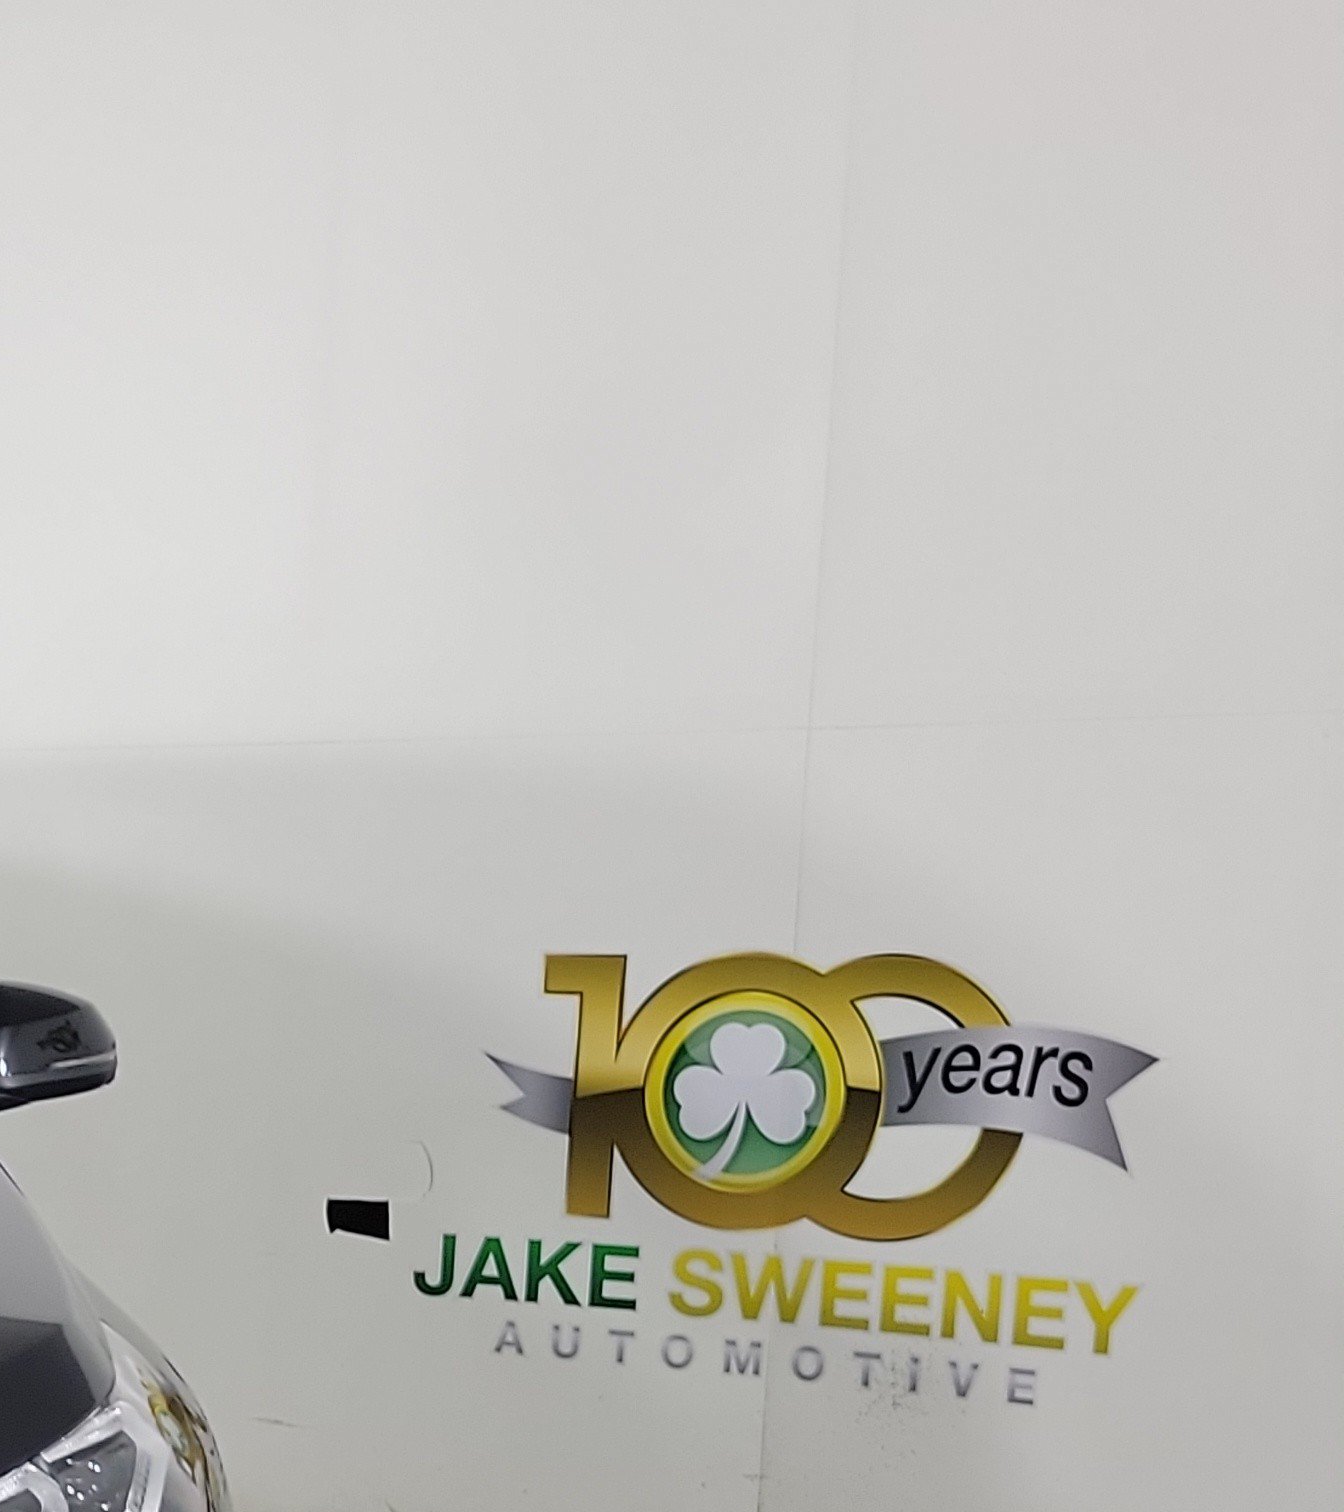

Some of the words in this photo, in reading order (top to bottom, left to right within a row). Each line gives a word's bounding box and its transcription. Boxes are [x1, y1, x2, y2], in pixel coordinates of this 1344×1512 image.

[543, 951, 1024, 1243] 100
[895, 1040, 1095, 1115] years
[411, 1232, 642, 1313] JAKE
[667, 1248, 1141, 1357] SWEENEY
[493, 1320, 1040, 1407] AUTOMOTIVE
